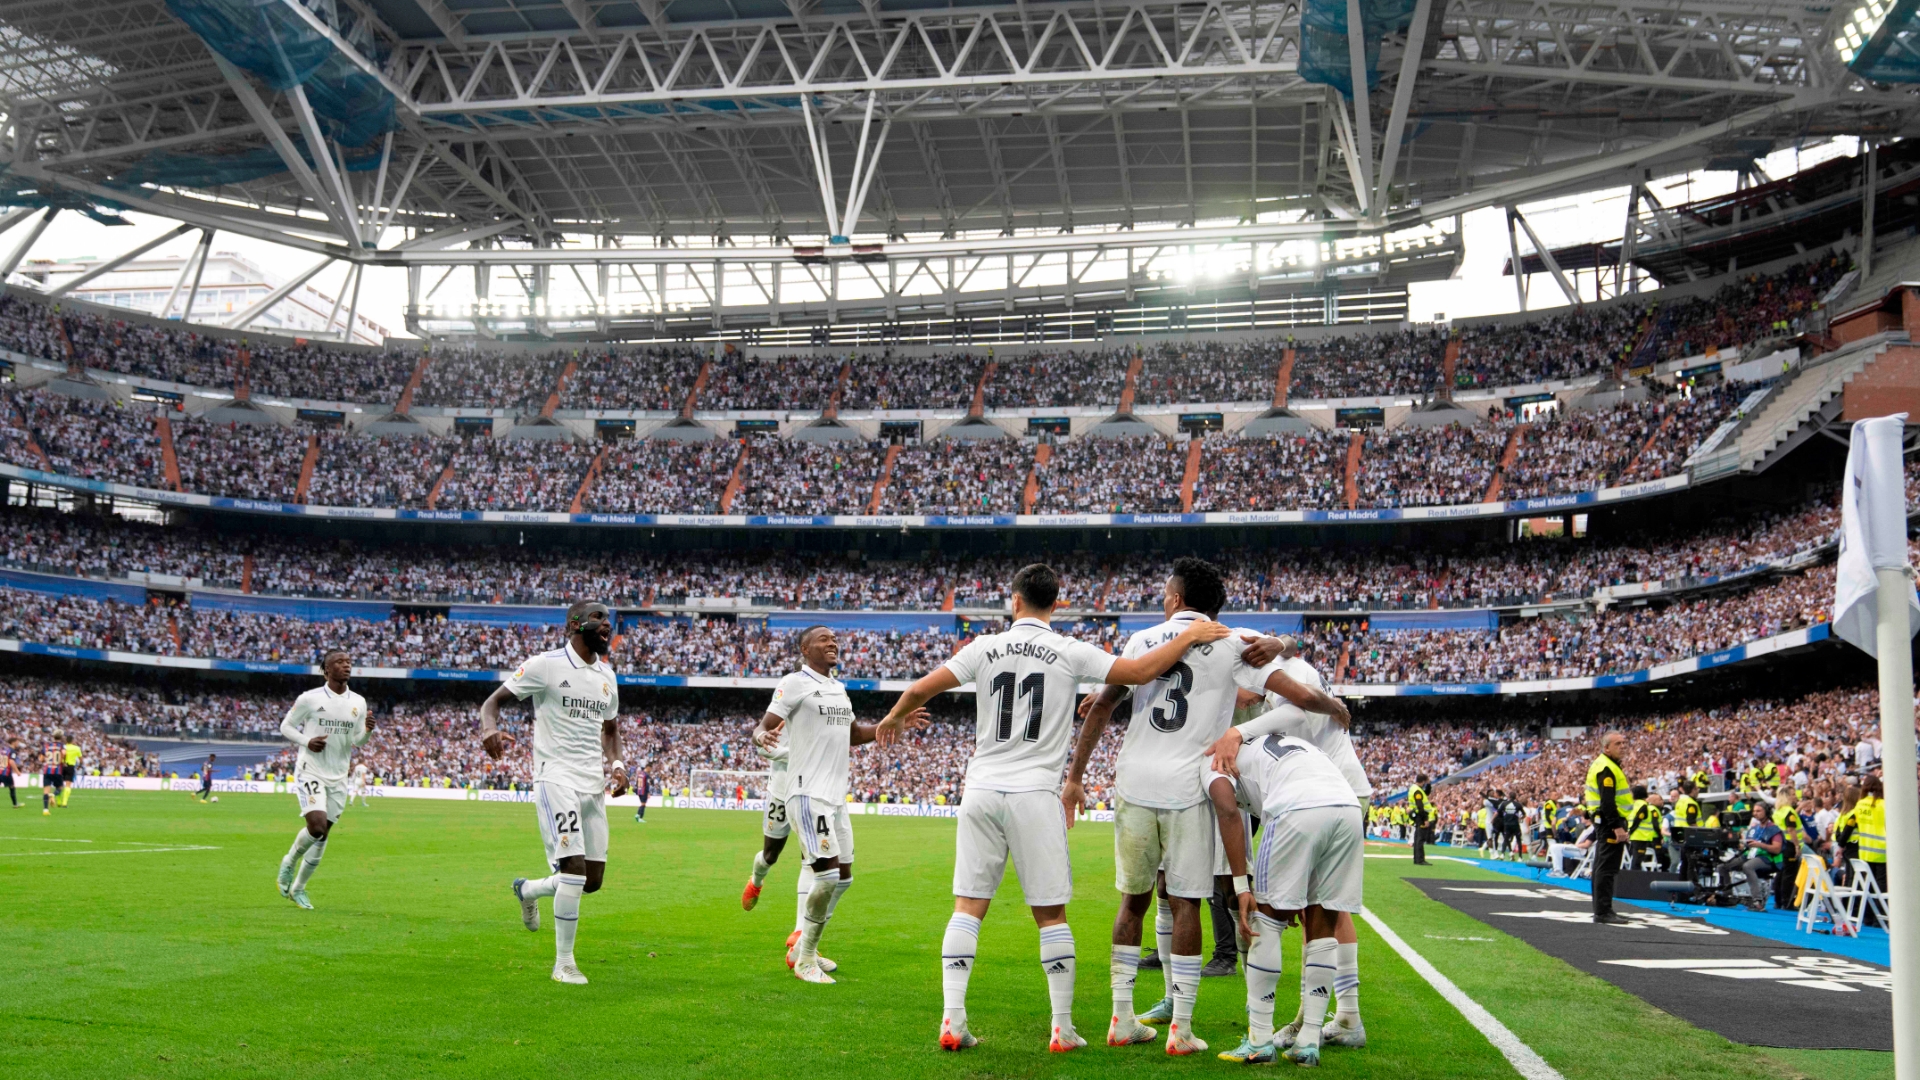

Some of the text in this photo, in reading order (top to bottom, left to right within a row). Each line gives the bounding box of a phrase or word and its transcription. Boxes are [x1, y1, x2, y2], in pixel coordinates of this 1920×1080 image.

[1620, 481, 1666, 498] Real Madrid
[137, 490, 187, 503] Real Madrid
[234, 500, 282, 511] Real Madrid
[1528, 496, 1576, 509] Real Madrid
[417, 511, 461, 520] Real Madrid
[1328, 511, 1378, 520] Real Madrid
[1428, 507, 1479, 517] Real Madrid
[504, 514, 548, 522] Real Madrid
[591, 514, 636, 523] Real Madrid
[678, 517, 724, 525] Real Madrid
[767, 516, 812, 525] Real Madrid
[856, 518, 902, 526] Real Madrid
[948, 516, 994, 525] Real Madrid
[1039, 517, 1087, 525] Real Madrid
[1134, 514, 1181, 523] Real Madrid
[1229, 514, 1279, 523] Real Madrid
[1145, 637, 1158, 649] E.
[986, 643, 1058, 665] M. ASENSIO
[1150, 661, 1194, 733] 3
[562, 696, 608, 711] Emirates
[990, 671, 1045, 743] 11
[569, 708, 581, 718] FLY
[827, 716, 836, 726] FLY
[46, 751, 61, 765] 20
[304, 780, 321, 795] 12
[768, 801, 786, 822] 23
[882, 804, 959, 818] easyMark
[555, 810, 579, 834] 22
[816, 814, 830, 836] 4
